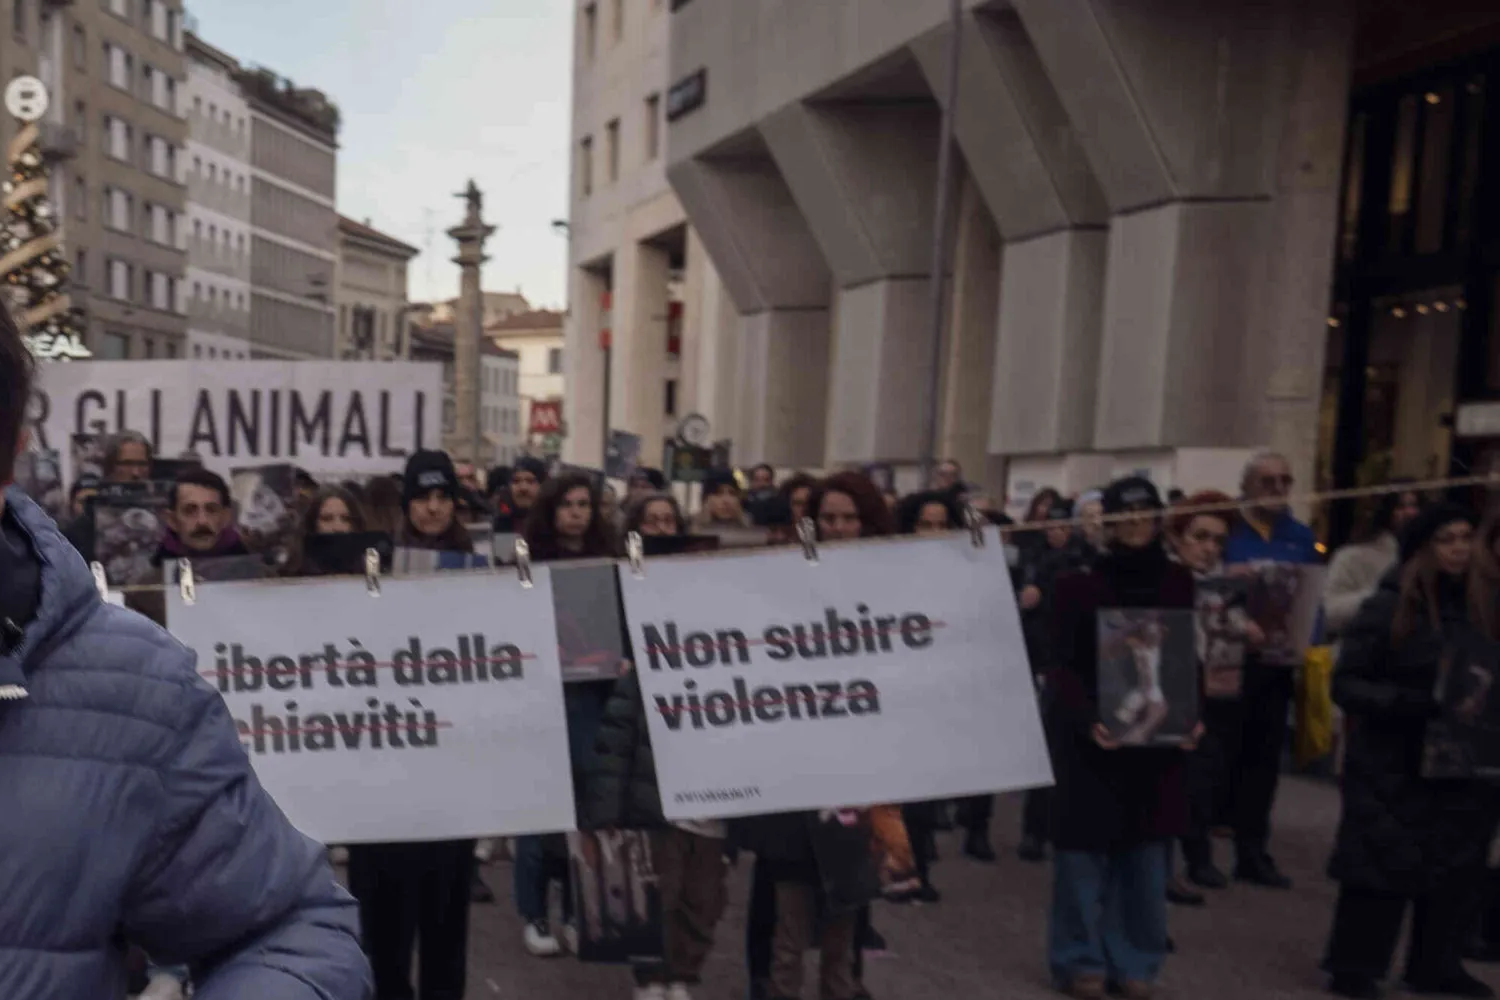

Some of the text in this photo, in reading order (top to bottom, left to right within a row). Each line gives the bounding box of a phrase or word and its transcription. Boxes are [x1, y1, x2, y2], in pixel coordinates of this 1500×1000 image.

[21, 331, 93, 357] EAL
[187, 388, 426, 459] ANIMALI
[391, 634, 523, 686] dalla
[643, 604, 933, 671] Non subire
[652, 677, 881, 733] violenza
